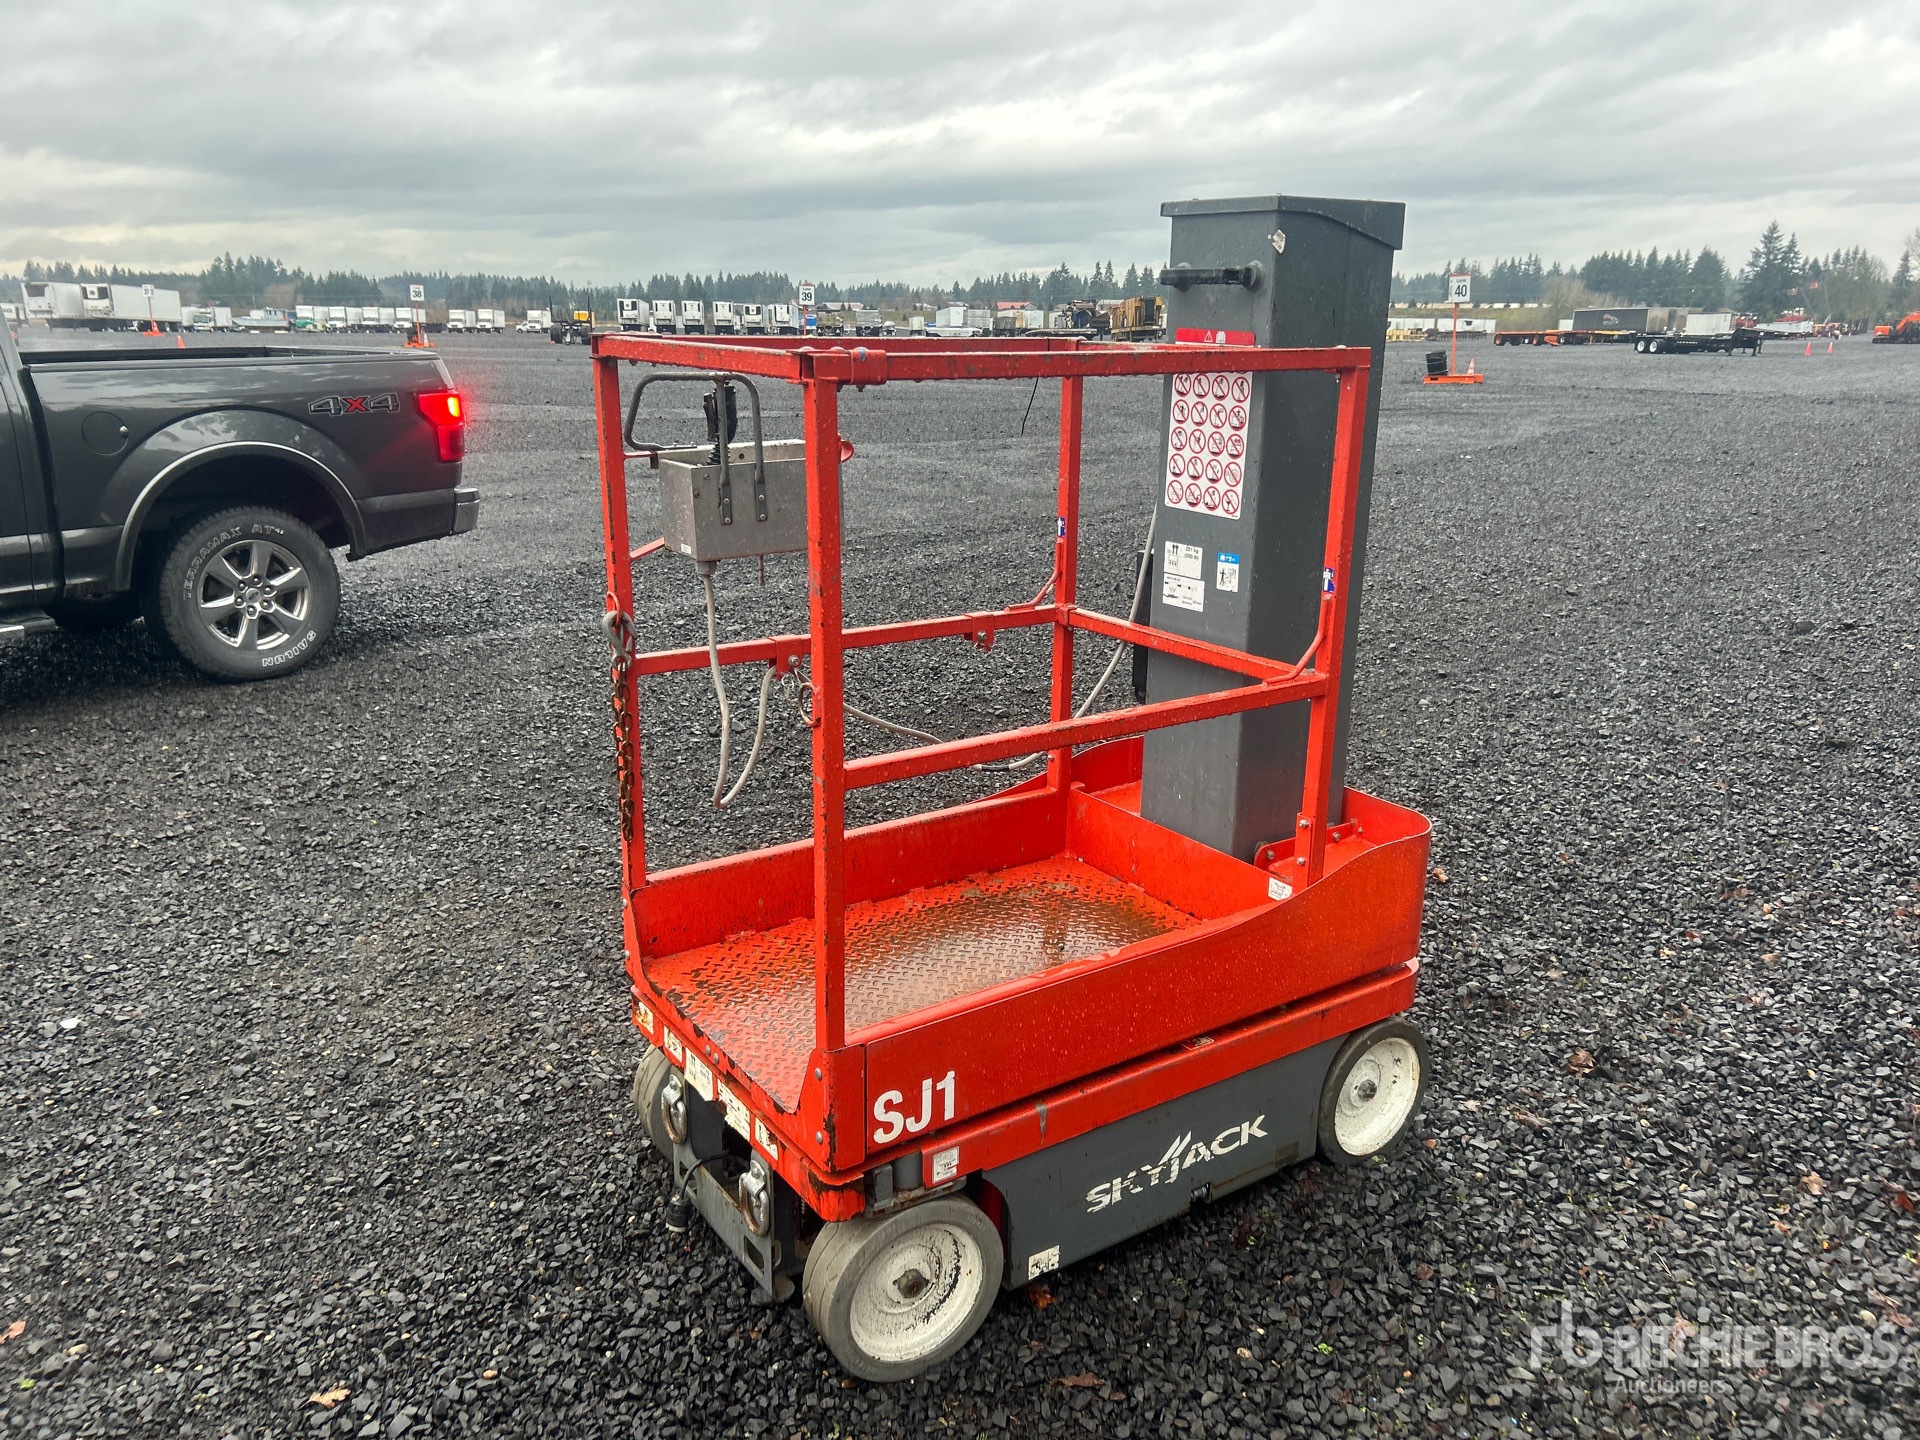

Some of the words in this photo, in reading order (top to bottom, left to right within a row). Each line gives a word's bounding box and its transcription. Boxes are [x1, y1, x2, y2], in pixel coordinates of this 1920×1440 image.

[412, 289, 422, 298] 38
[801, 291, 812, 302] 39
[1455, 284, 1467, 297] 40
[183, 526, 241, 599] TERRAMAX
[262, 630, 317, 668] SAILUN
[873, 1070, 956, 1144] SJ1
[1085, 1114, 1269, 1214] SKYJACK
